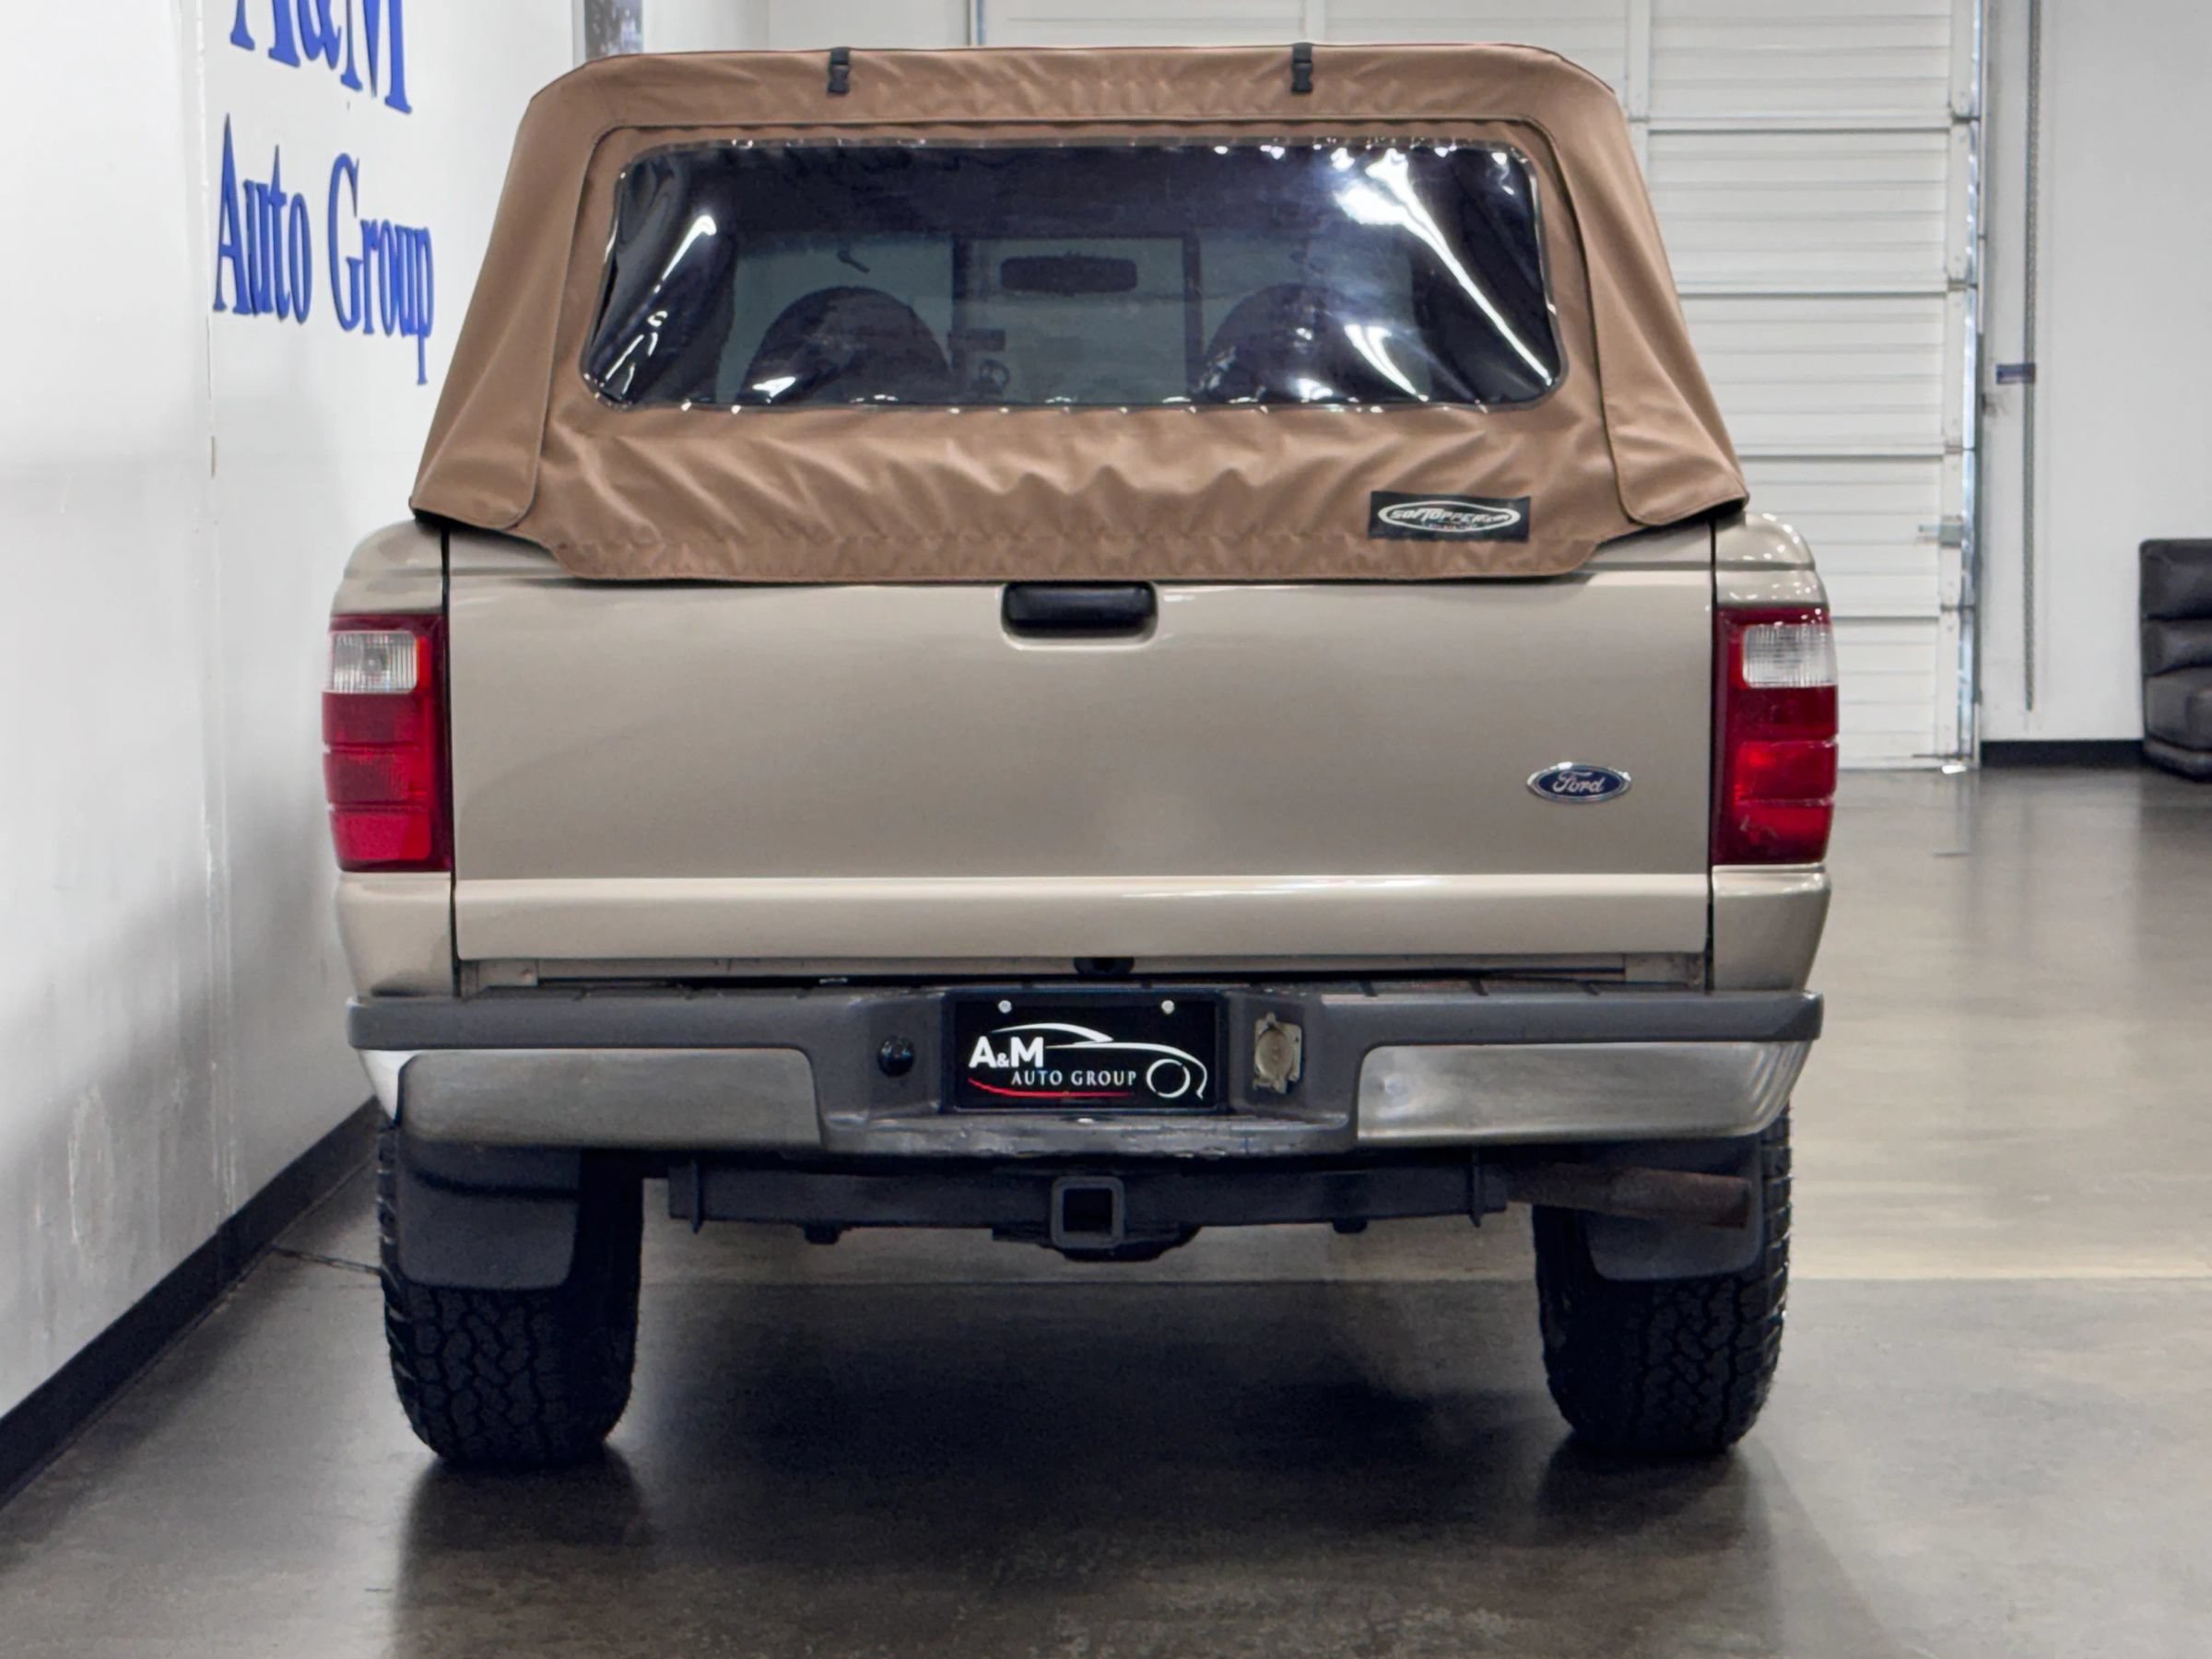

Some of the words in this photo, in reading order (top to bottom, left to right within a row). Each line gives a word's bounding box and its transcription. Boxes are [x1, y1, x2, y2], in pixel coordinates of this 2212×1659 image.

[213, 112, 312, 324] Auto
[327, 152, 434, 385] Group
[1552, 771, 1606, 793] Ford
[968, 1035, 1044, 1068] A&M
[1011, 1070, 1063, 1086] AUTO
[1070, 1070, 1136, 1086] GROUP
